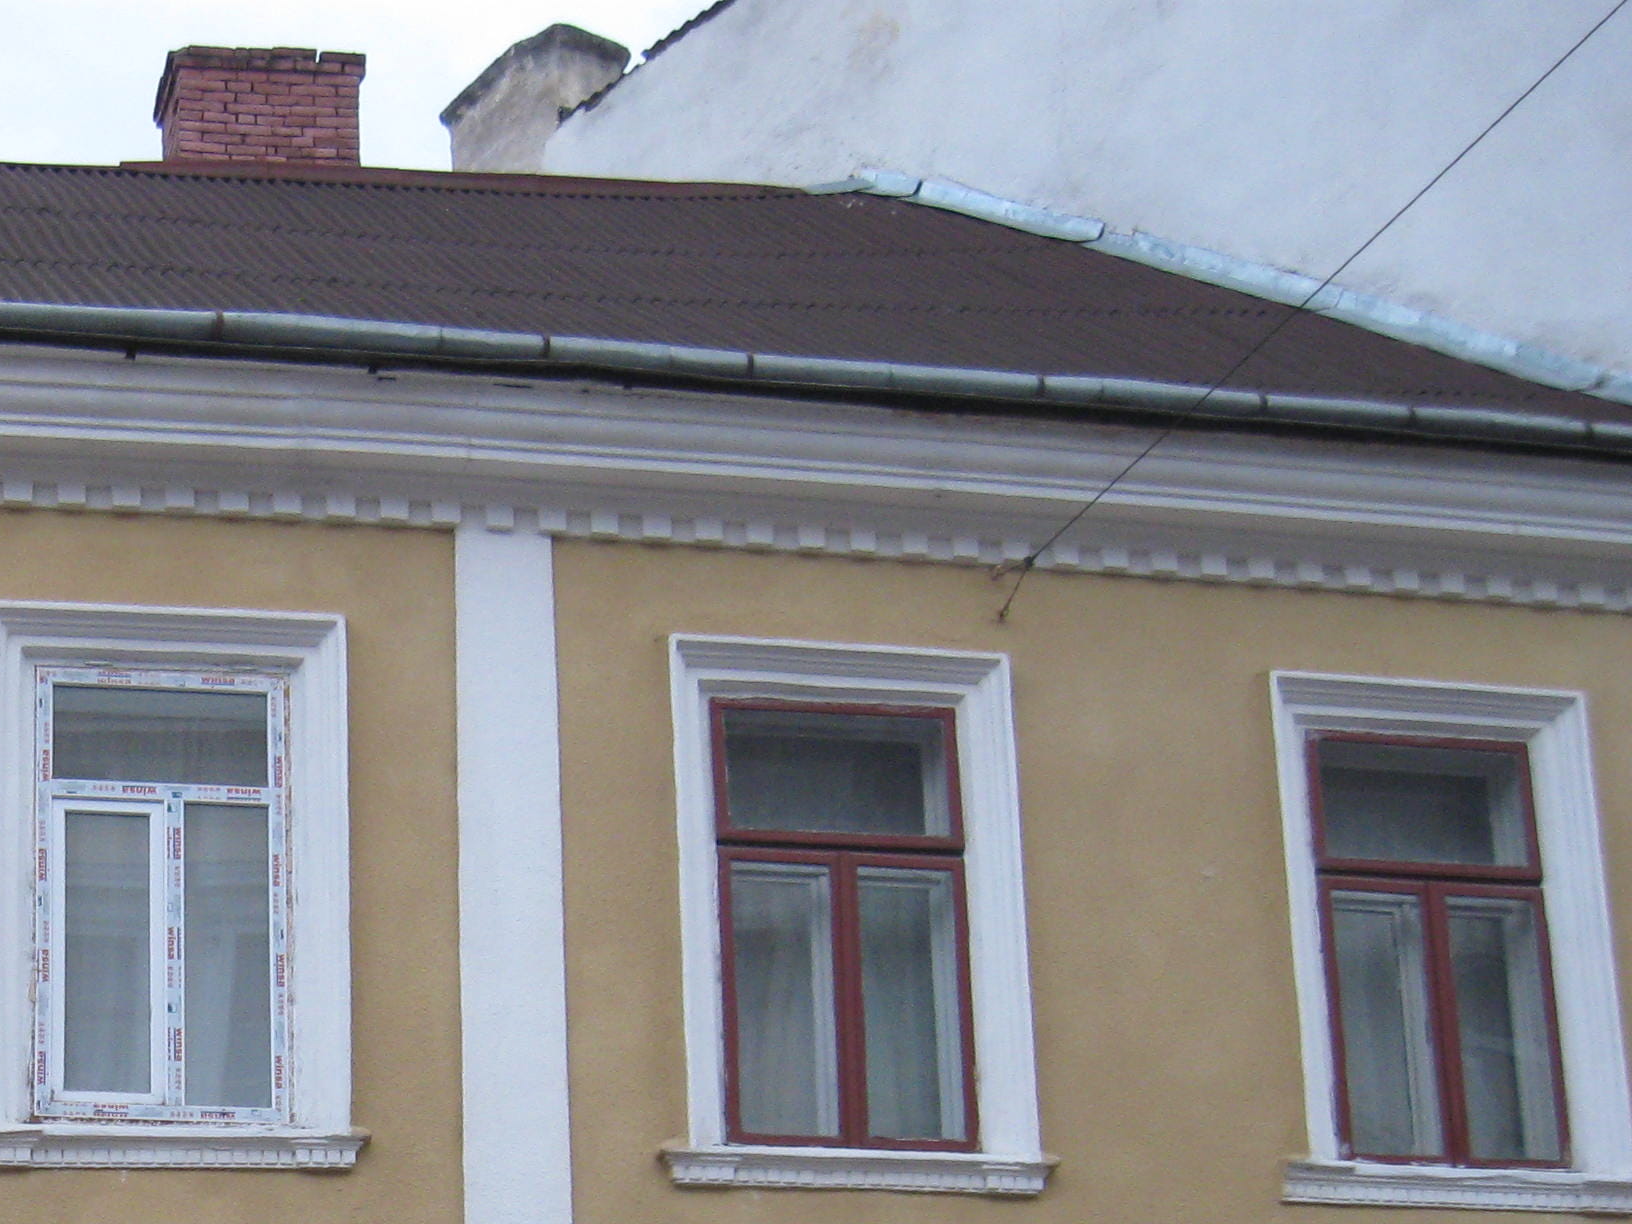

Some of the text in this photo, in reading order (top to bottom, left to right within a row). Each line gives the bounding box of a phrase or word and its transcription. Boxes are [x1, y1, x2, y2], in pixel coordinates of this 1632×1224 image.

[42, 749, 50, 782] winsa
[122, 785, 157, 795] winsa
[173, 827, 181, 860] winsa
[39, 848, 47, 881] winsa
[272, 854, 280, 887] winsa
[41, 949, 49, 983] winsa
[275, 953, 285, 987] winsa
[174, 1028, 182, 1061] winsa
[37, 1050, 46, 1084] winsa
[275, 1055, 283, 1089] winsa
